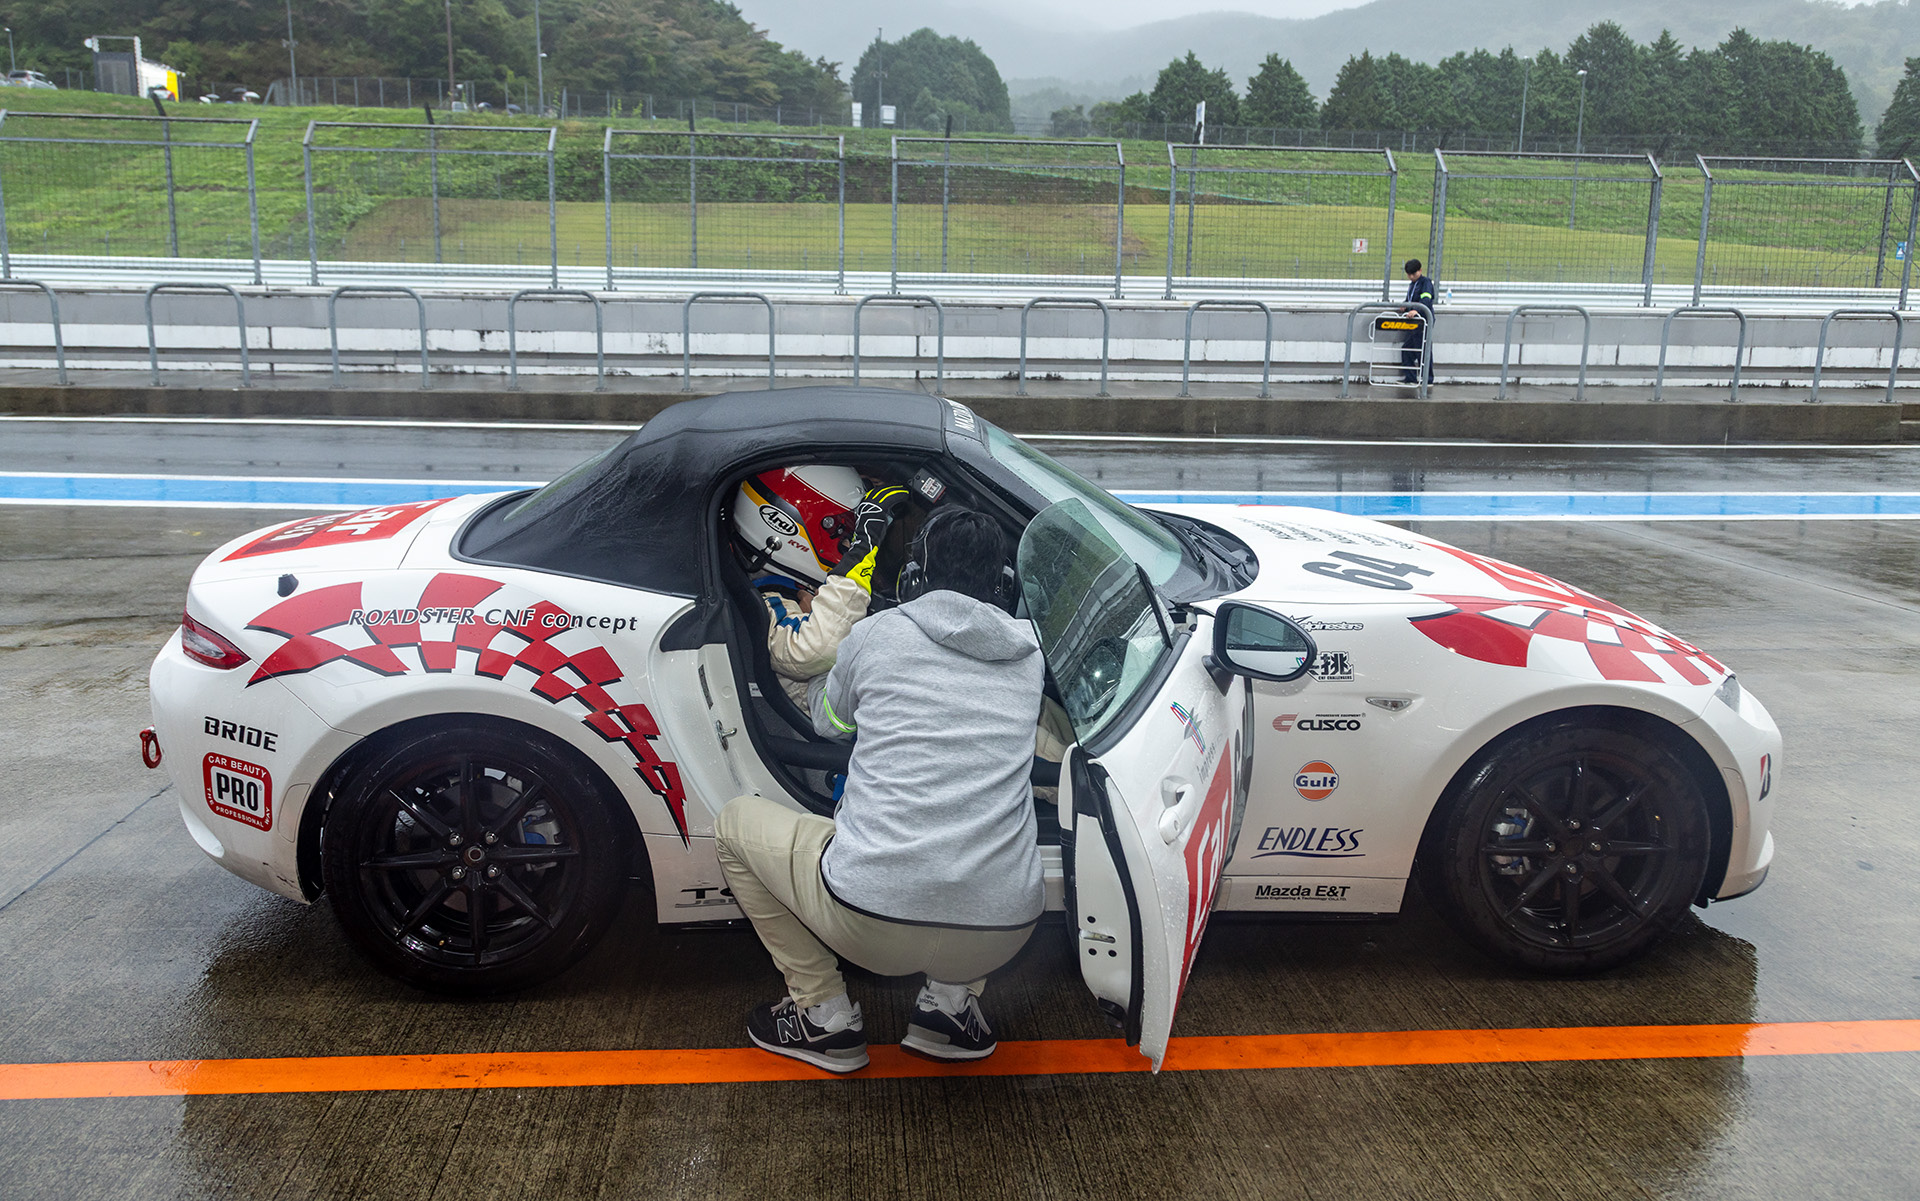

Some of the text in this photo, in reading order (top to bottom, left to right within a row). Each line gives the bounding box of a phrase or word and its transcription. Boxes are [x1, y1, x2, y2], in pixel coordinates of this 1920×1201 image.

[761, 511, 796, 533] Arai
[1302, 550, 1435, 591] 64
[349, 608, 638, 635] ROADSTER CNF concept
[204, 716, 278, 753] BRIDE
[1297, 719, 1361, 731] CUSCO
[208, 755, 267, 779] CAR BEAUTY
[216, 772, 259, 812] PRO
[1296, 775, 1337, 788] Gulf
[215, 805, 265, 828] PROFESSIONAL
[1257, 827, 1364, 852] ENDLESS
[1256, 885, 1350, 897] Mazda E&T
